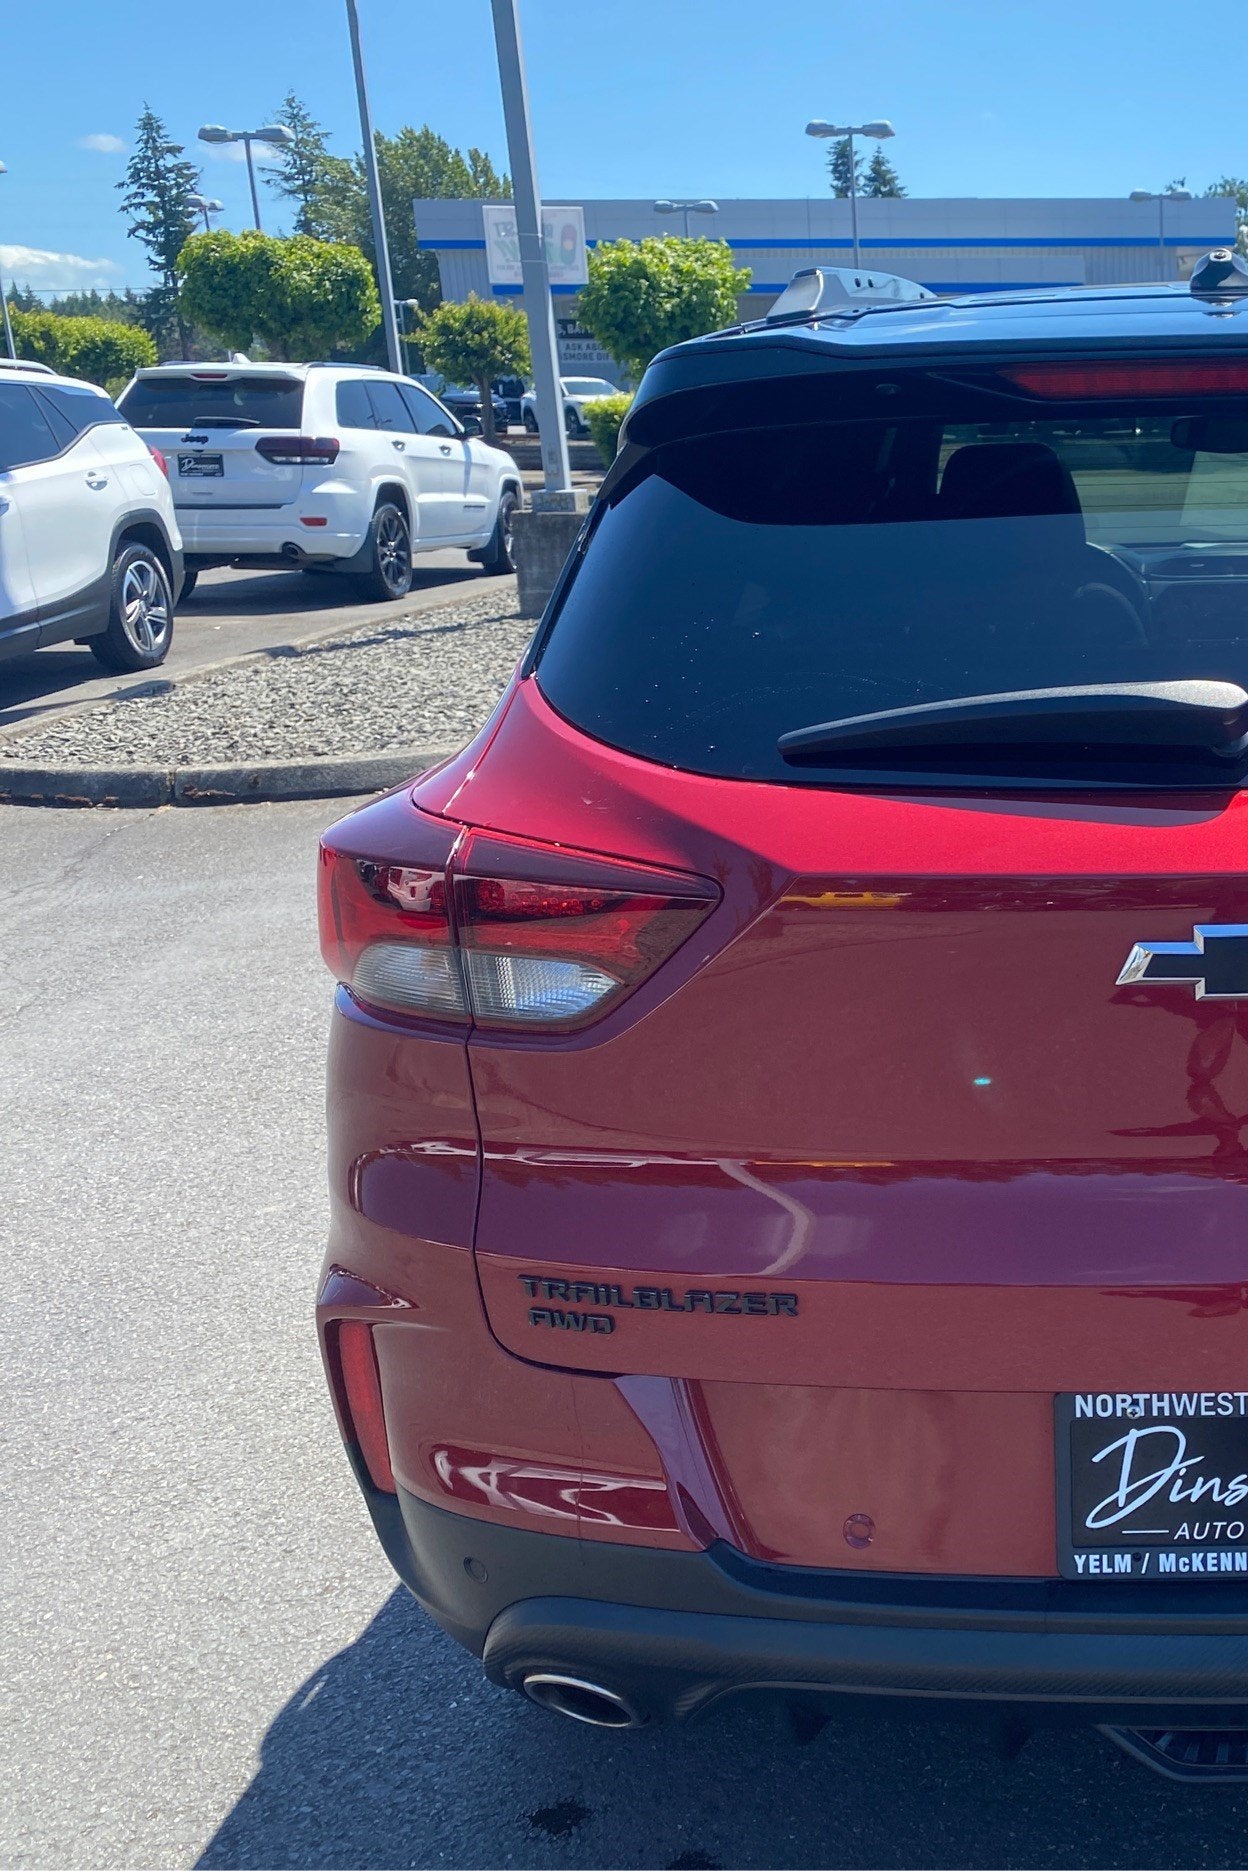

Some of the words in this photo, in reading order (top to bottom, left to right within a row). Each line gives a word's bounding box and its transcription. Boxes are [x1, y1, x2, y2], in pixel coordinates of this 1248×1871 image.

[565, 343, 583, 351] ASK
[517, 1273, 800, 1318] TRAILBLAZER
[527, 1306, 616, 1335] AWD
[1173, 1520, 1245, 1541] AUTO
[1073, 1552, 1132, 1575] YELM
